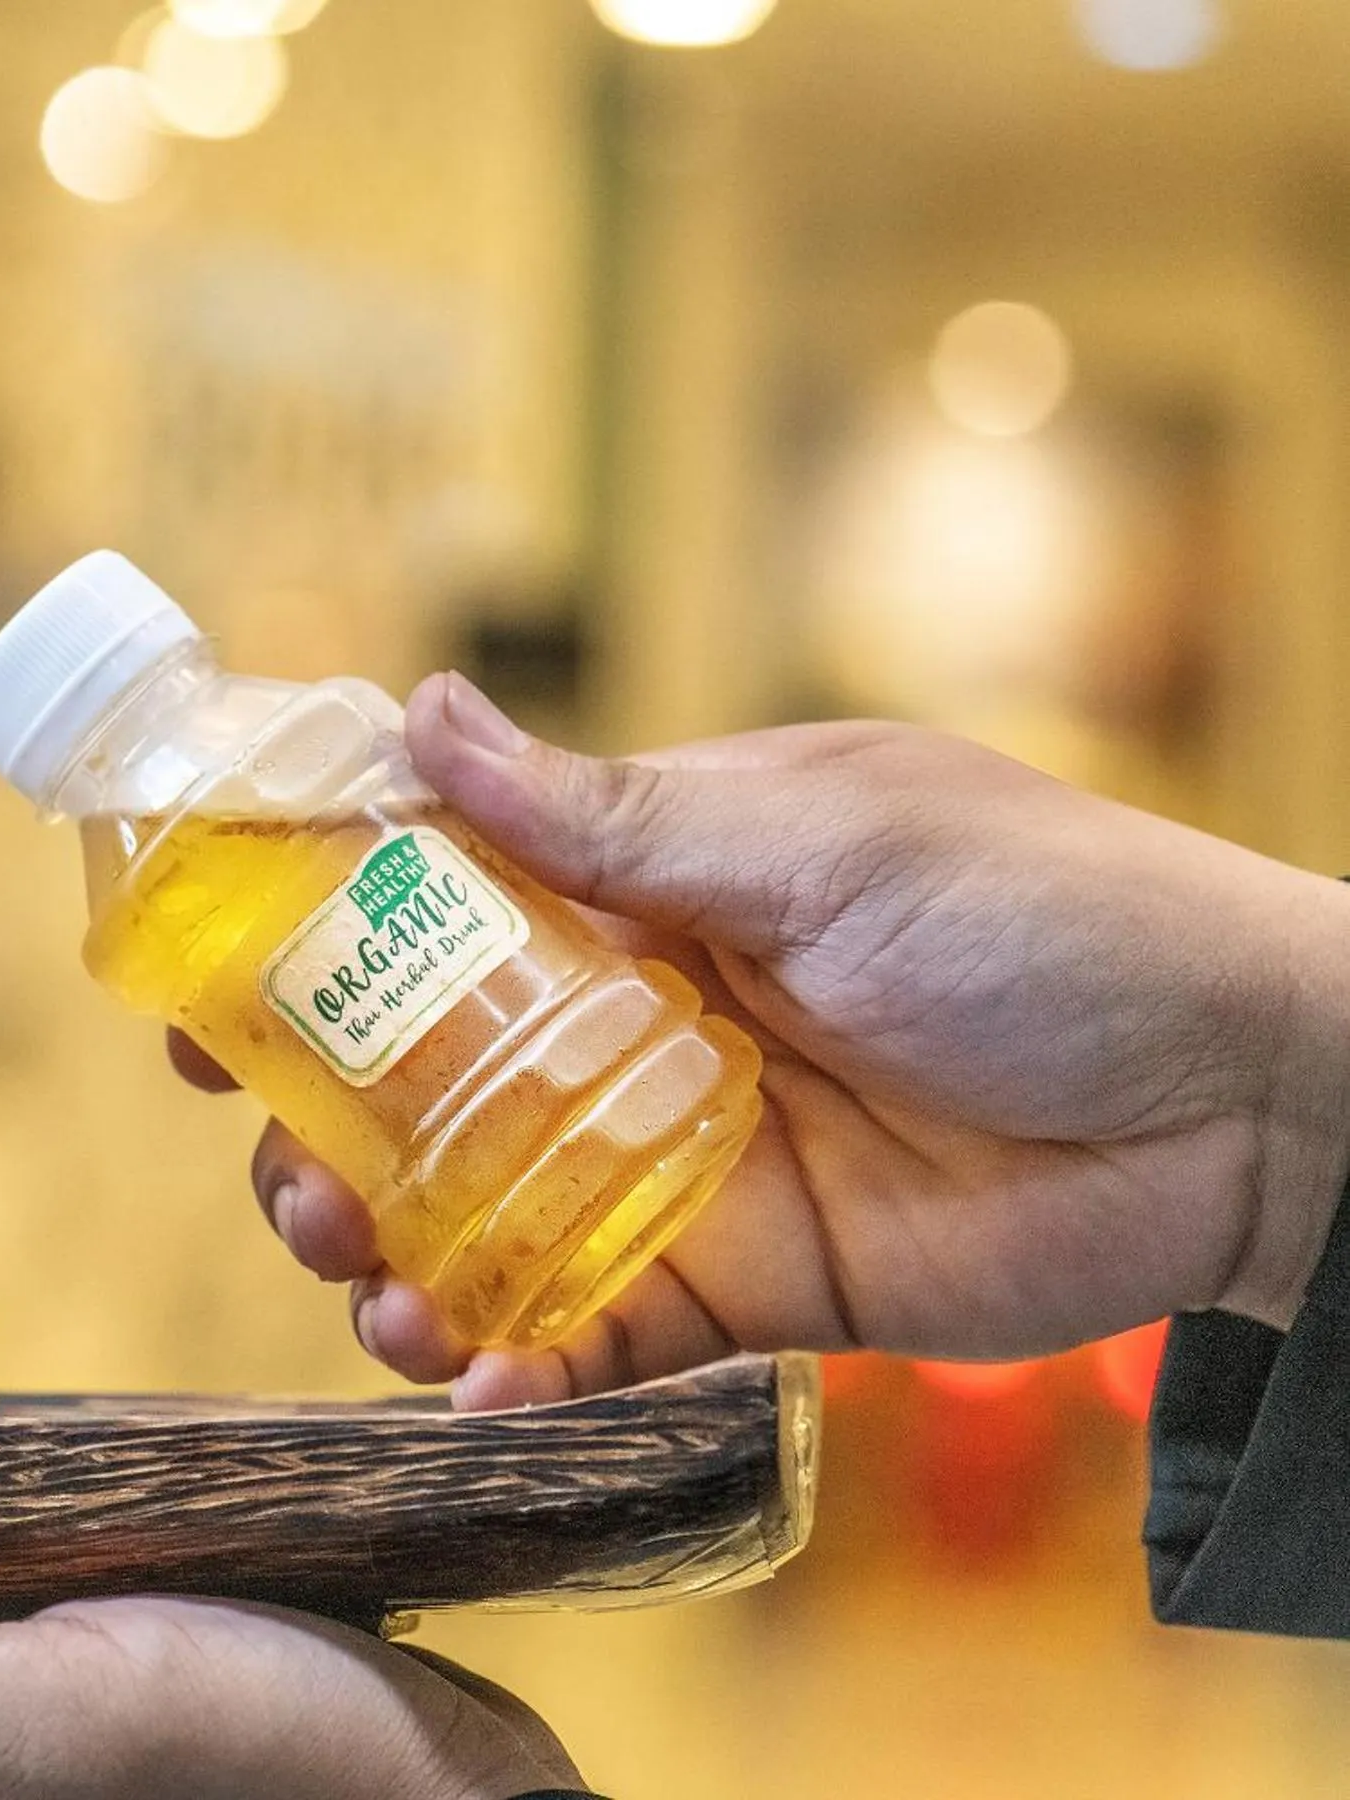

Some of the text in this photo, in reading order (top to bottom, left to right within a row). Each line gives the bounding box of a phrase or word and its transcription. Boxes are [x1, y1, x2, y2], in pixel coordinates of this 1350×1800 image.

[350, 844, 418, 902] FRESH &
[362, 855, 430, 917] HEALTHY
[312, 872, 468, 1024] ORGANIC
[343, 906, 488, 1045] Thai Herbal Drink
